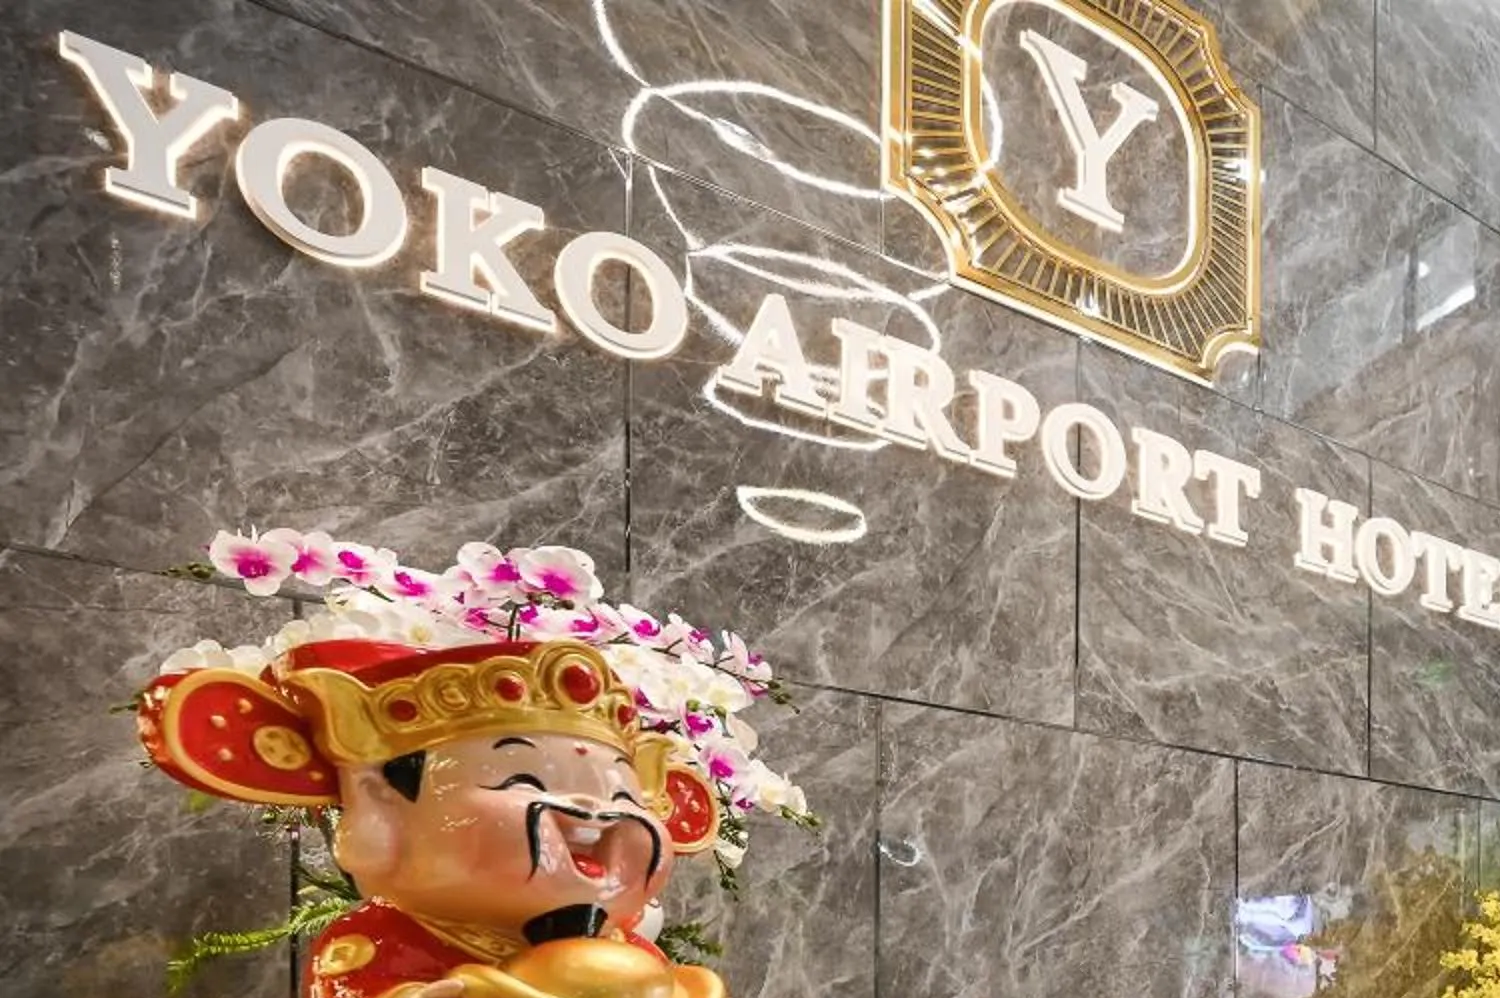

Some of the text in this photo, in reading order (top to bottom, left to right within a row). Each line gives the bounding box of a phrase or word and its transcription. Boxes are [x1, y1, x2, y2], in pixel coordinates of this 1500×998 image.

[59, 29, 689, 359] YOKO
[717, 293, 1261, 547] AIRPORT
[1020, 28, 1159, 233] Y
